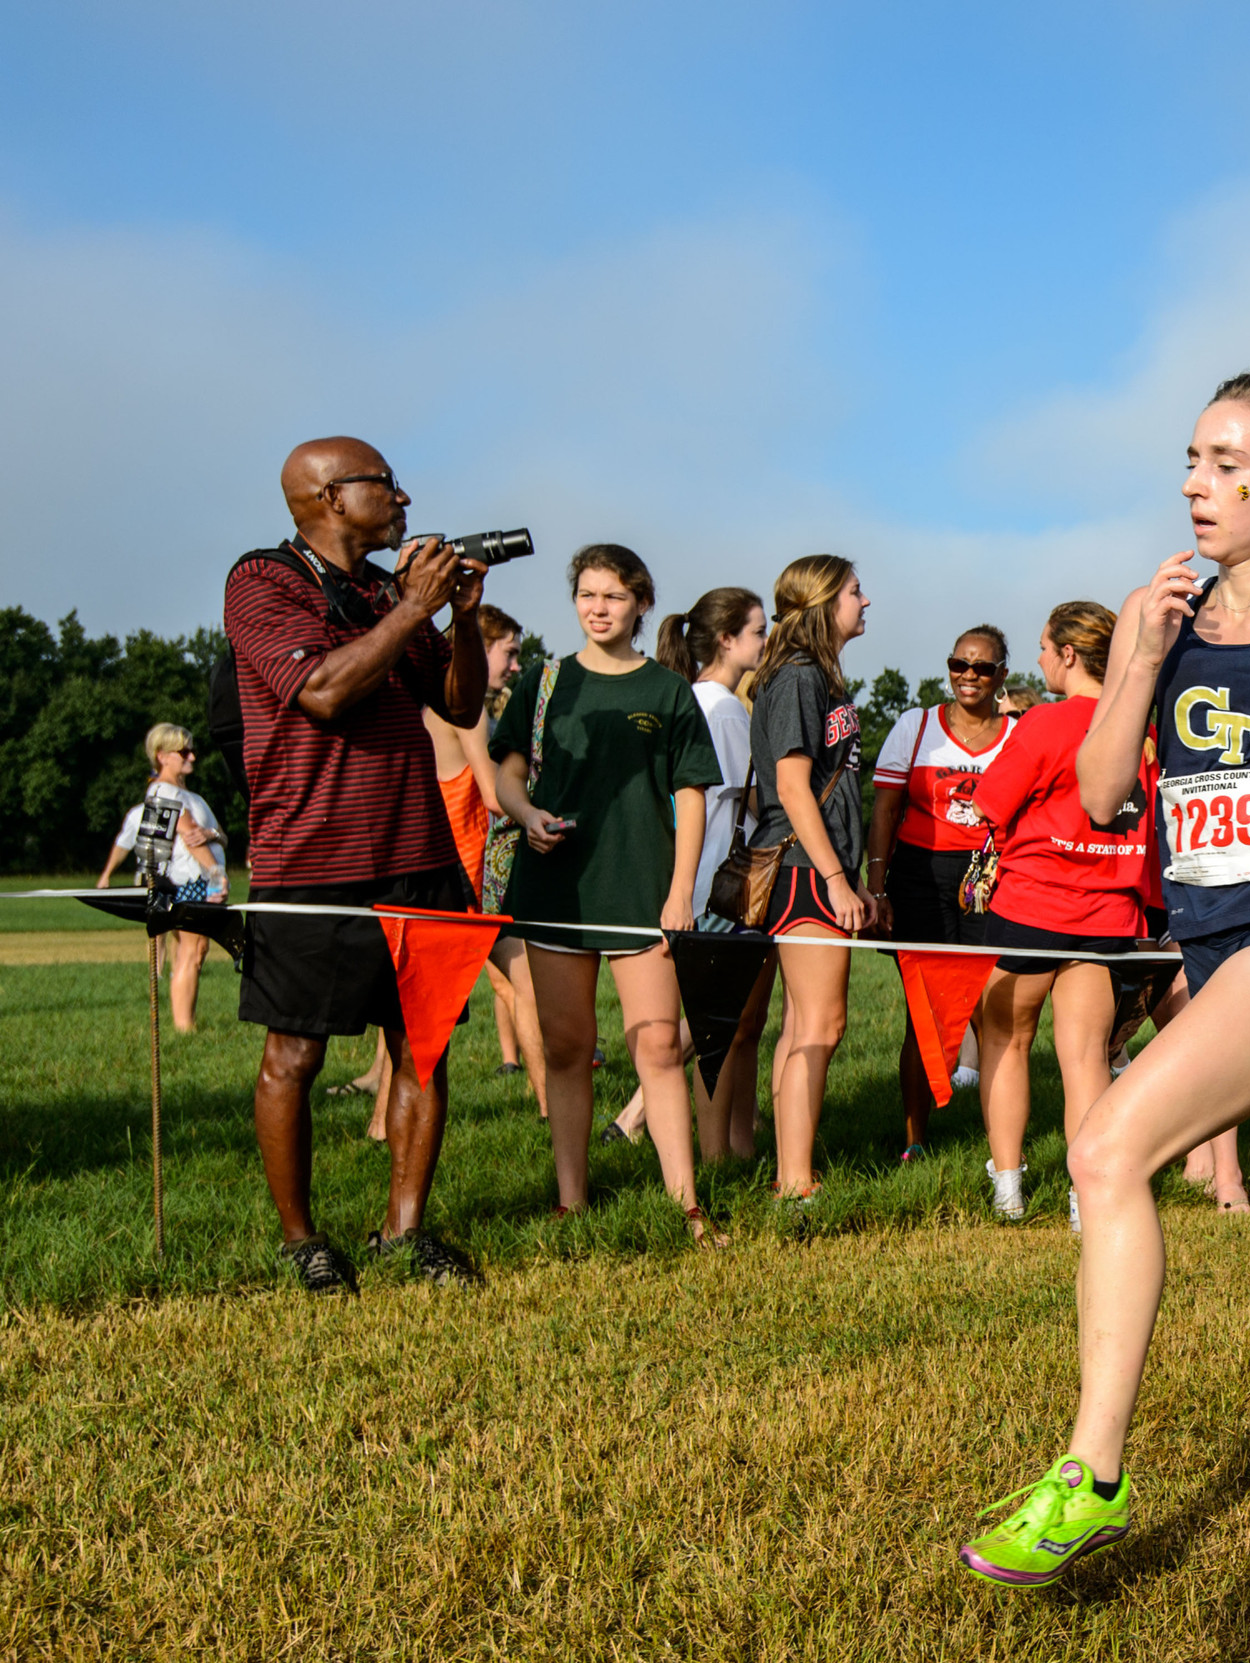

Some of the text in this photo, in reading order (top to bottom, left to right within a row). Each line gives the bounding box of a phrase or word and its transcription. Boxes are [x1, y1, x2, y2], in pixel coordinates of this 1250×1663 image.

[303, 550, 326, 574] SONY
[1162, 777, 1193, 789] GEORGIA
[1195, 773, 1221, 784] CROSS
[1182, 782, 1238, 795] INVITATIONAL
[1075, 842, 1085, 853] A
[1117, 844, 1134, 855] OF
